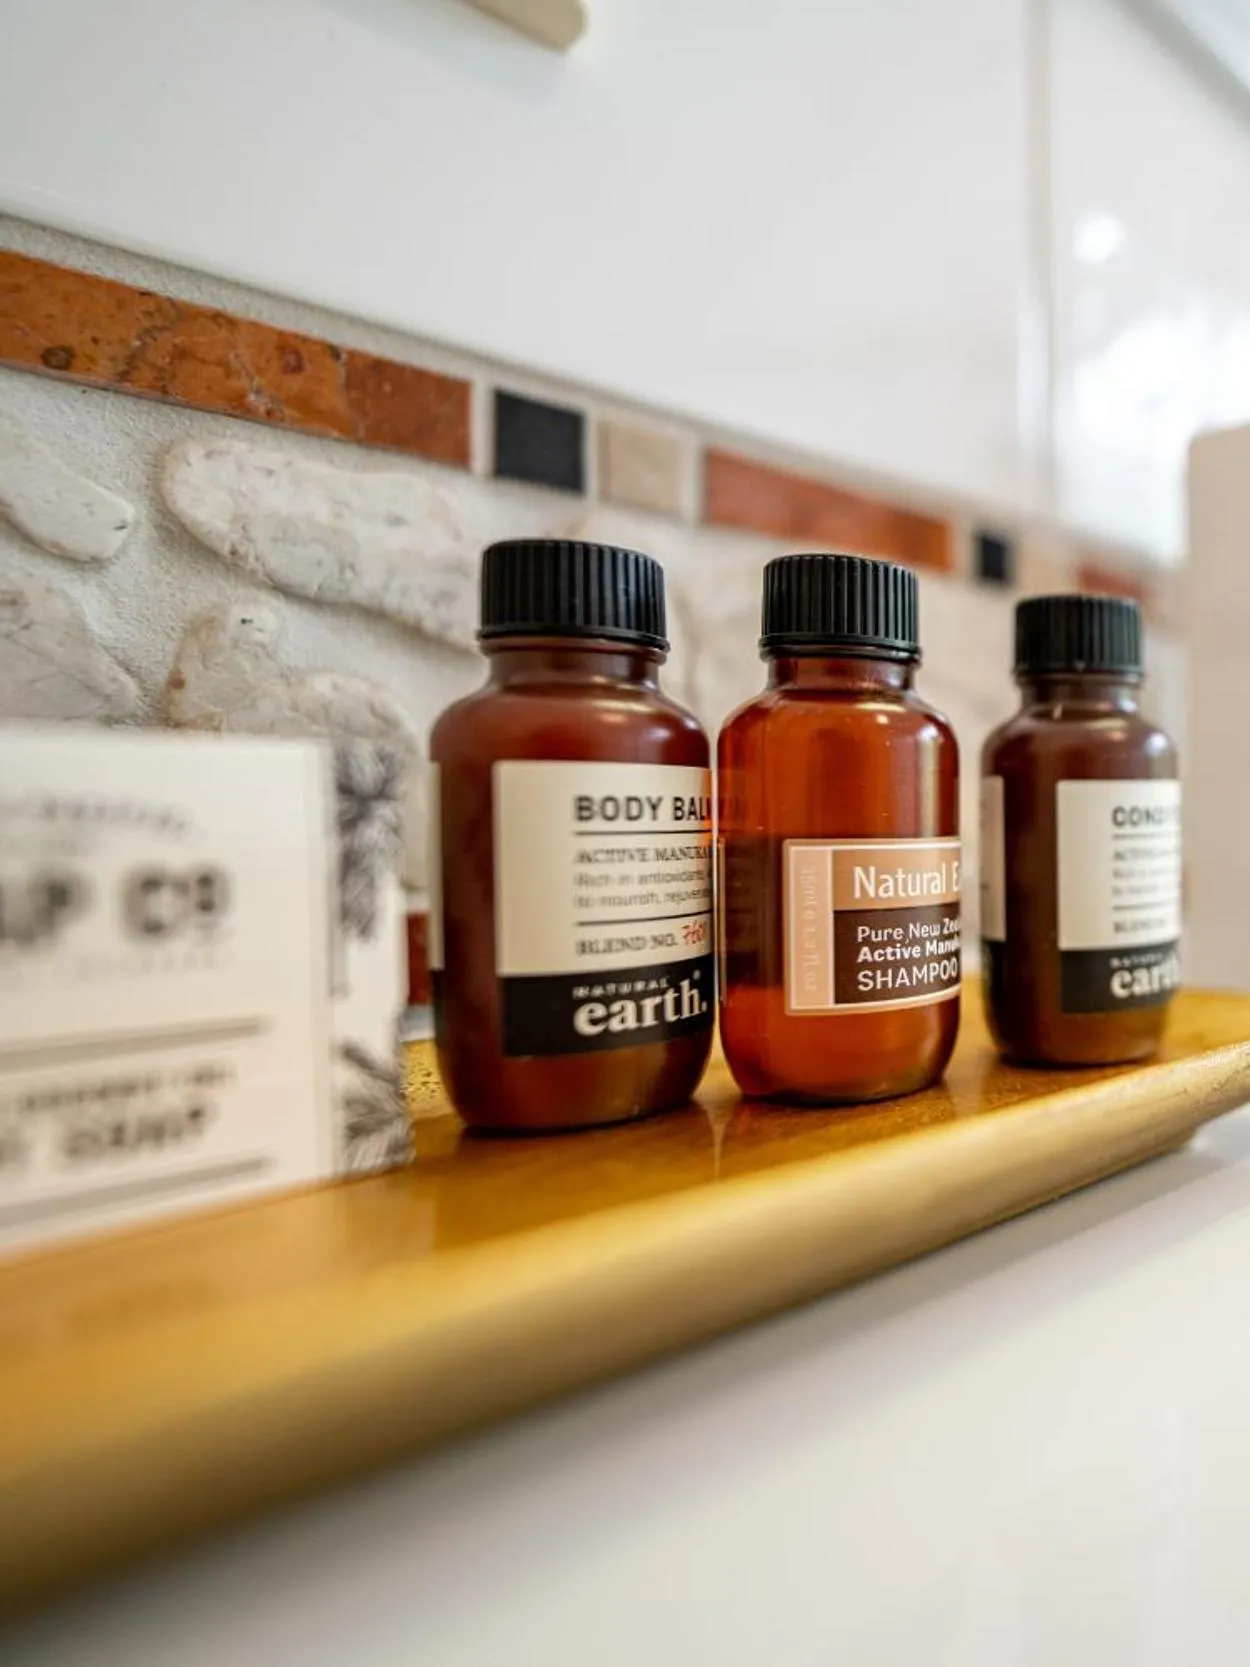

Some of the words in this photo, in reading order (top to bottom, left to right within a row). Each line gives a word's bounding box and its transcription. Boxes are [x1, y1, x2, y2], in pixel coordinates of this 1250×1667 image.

[574, 796, 663, 822] BODY
[854, 861, 946, 899] Natural
[857, 926, 904, 943] Pure
[909, 923, 941, 939] New
[857, 945, 921, 963] Active
[857, 958, 959, 992] SHAMPOO
[573, 979, 669, 999] NATURAL
